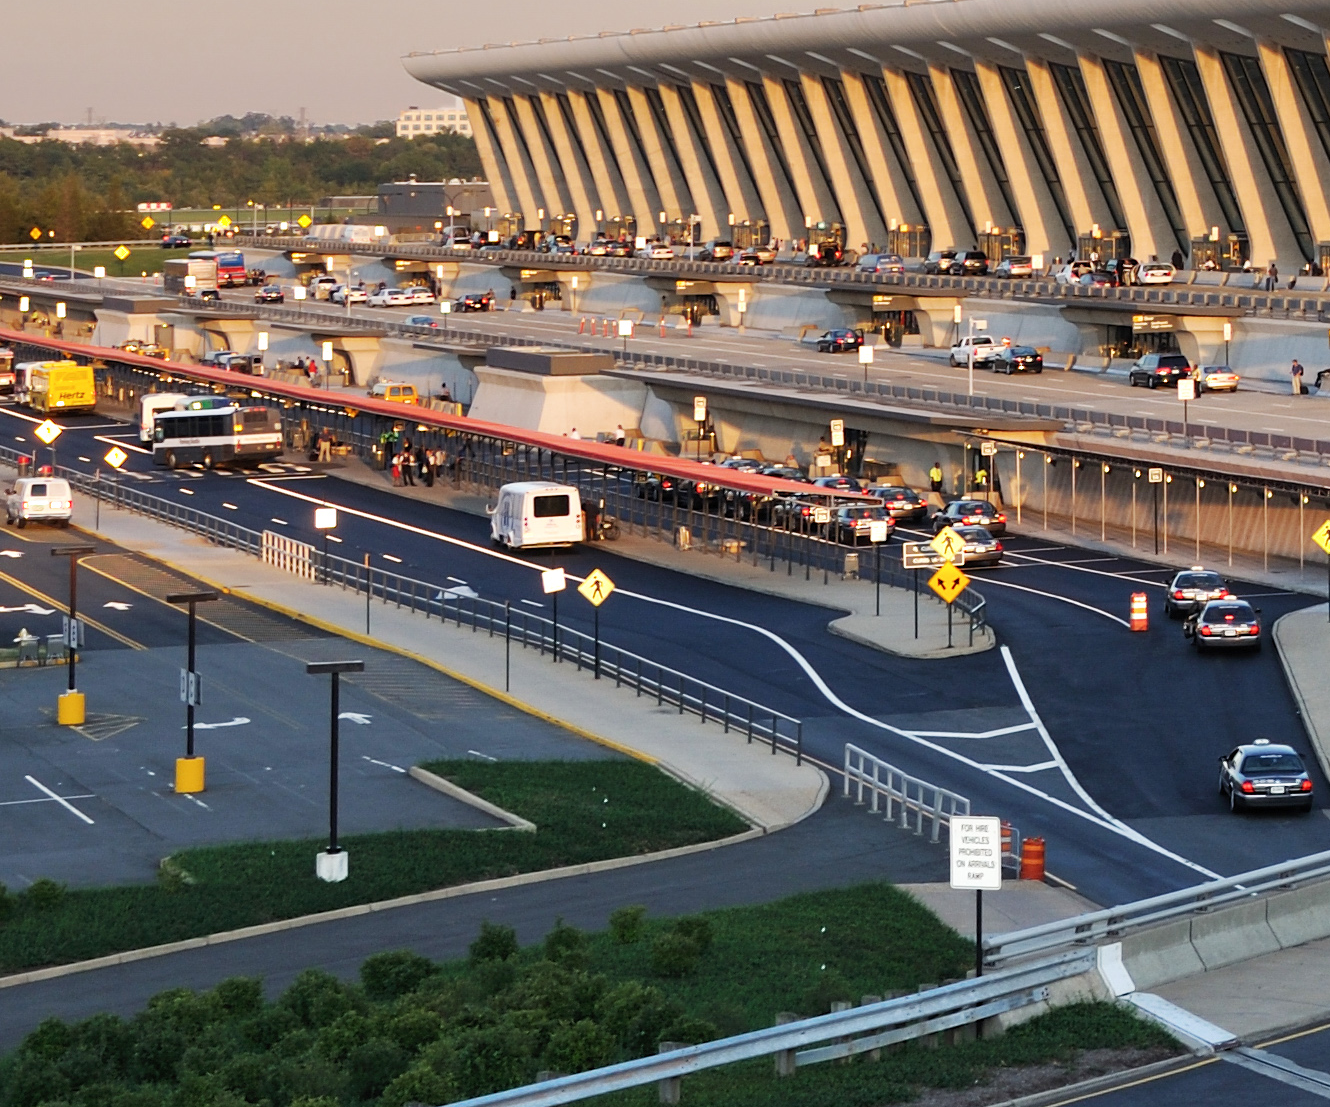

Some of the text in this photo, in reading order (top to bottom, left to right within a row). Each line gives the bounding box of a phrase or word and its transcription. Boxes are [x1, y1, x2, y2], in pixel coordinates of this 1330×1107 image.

[961, 824, 989, 832] FOR HIRE
[962, 836, 989, 844] VEHICLES
[959, 848, 992, 856] PROHIBITED
[956, 860, 995, 868] ON ARRIVALS
